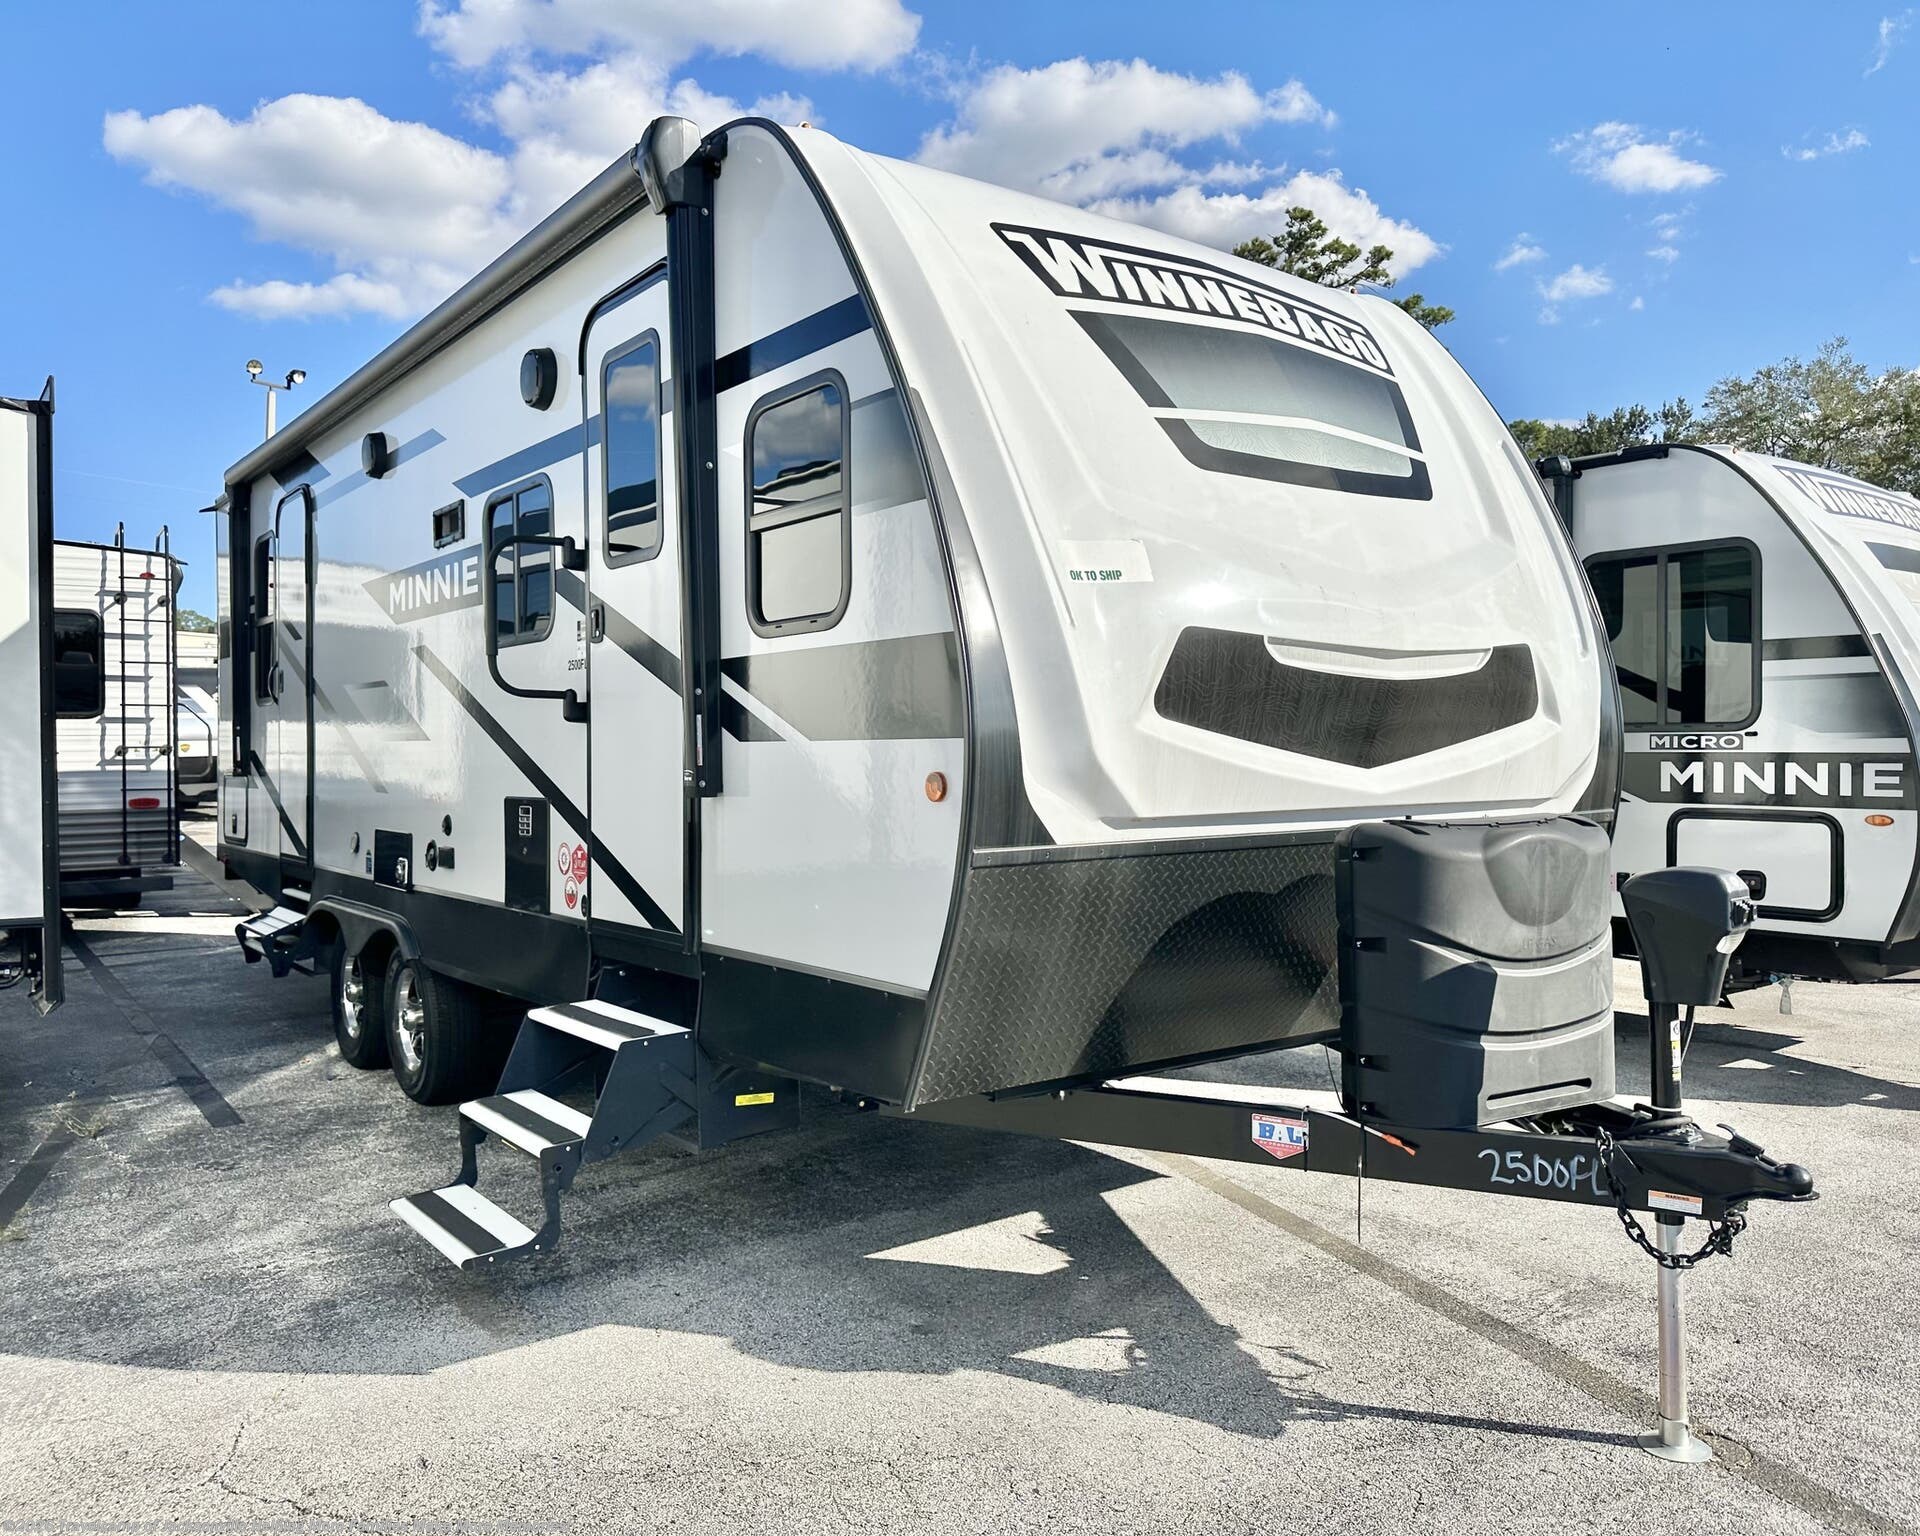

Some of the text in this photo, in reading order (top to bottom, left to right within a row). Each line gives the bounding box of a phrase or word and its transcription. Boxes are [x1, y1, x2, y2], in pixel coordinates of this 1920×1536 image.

[1000, 229, 1390, 371] WINNEBAGO
[1779, 468, 1920, 532] WINNEBAG
[388, 555, 479, 616] MINNIE
[1069, 569, 1122, 581] OK TO SHIP
[1651, 735, 1741, 749] MICRO
[1660, 761, 1904, 798] MINNIE
